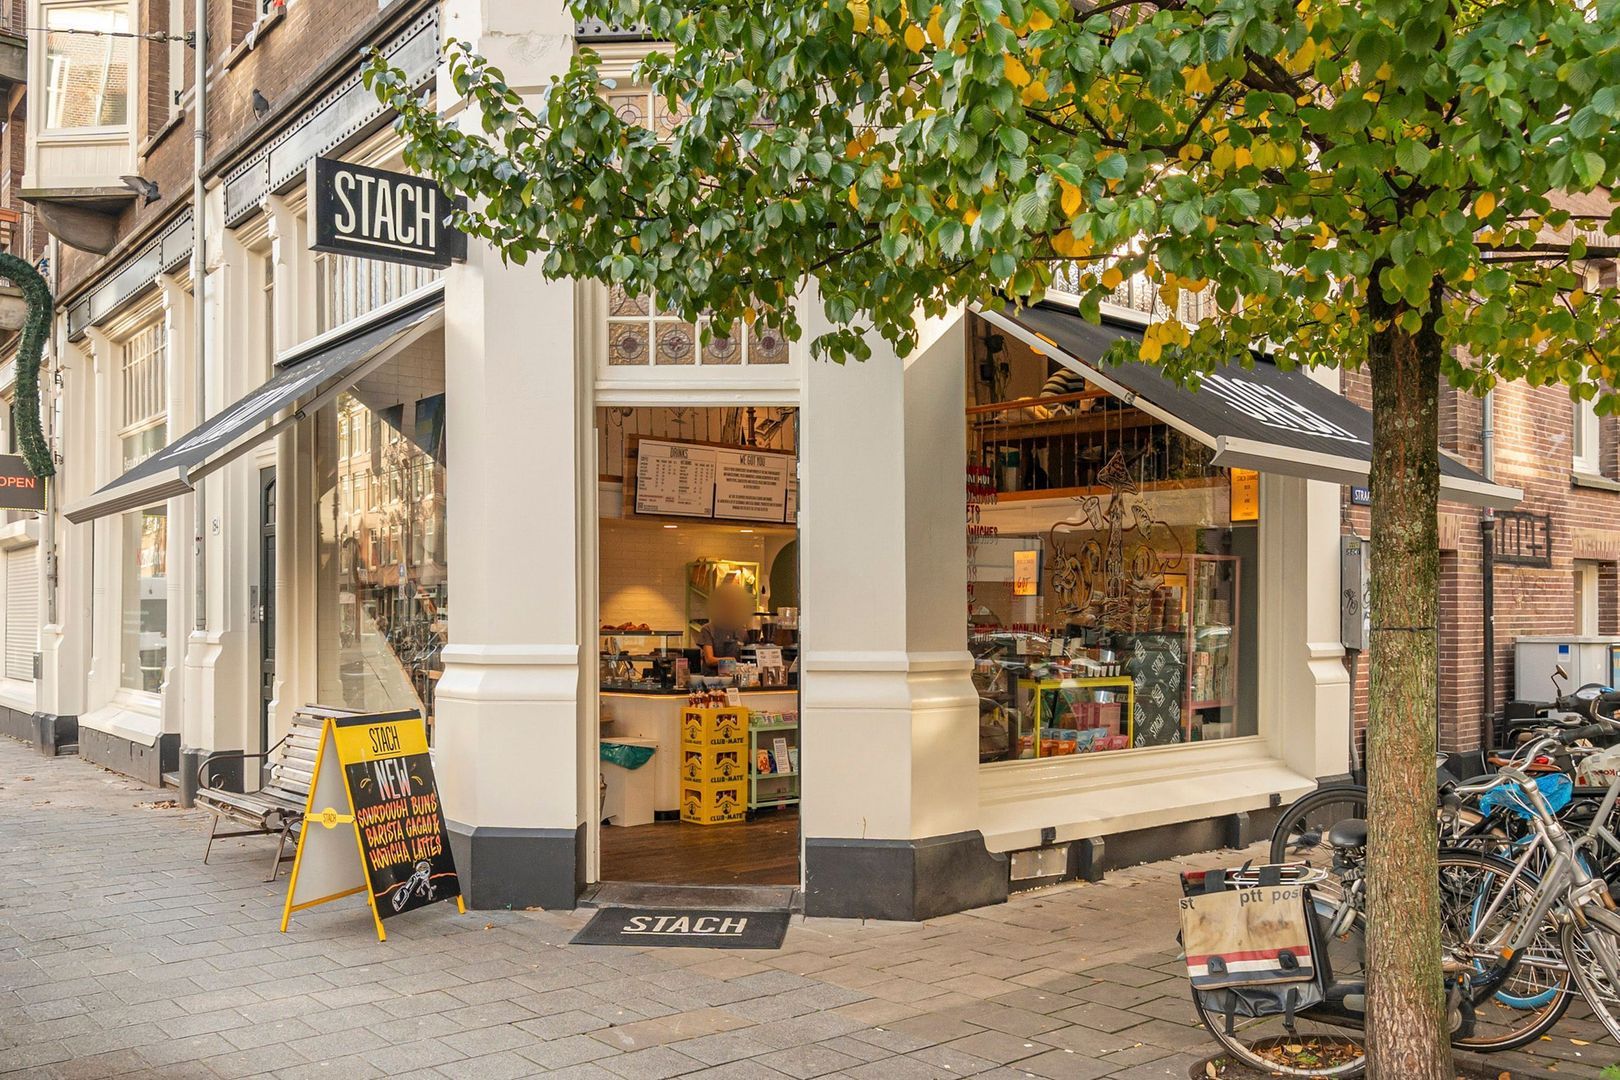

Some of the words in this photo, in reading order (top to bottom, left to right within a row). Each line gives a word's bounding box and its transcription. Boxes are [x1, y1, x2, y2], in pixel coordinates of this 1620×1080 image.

[334, 170, 436, 249] STACH
[0, 476, 35, 489] OPEN
[368, 725, 400, 752] STACH
[374, 758, 411, 801] NEW
[357, 799, 409, 827] SOURDOUGH
[410, 792, 438, 814] BUNS
[365, 822, 403, 848] BARISTA
[412, 835, 442, 861] LATTES
[1181, 898, 1195, 910] st
[1239, 889, 1263, 907] ptt
[622, 915, 748, 934] STACH
[1511, 888, 1544, 945] Gazelle
